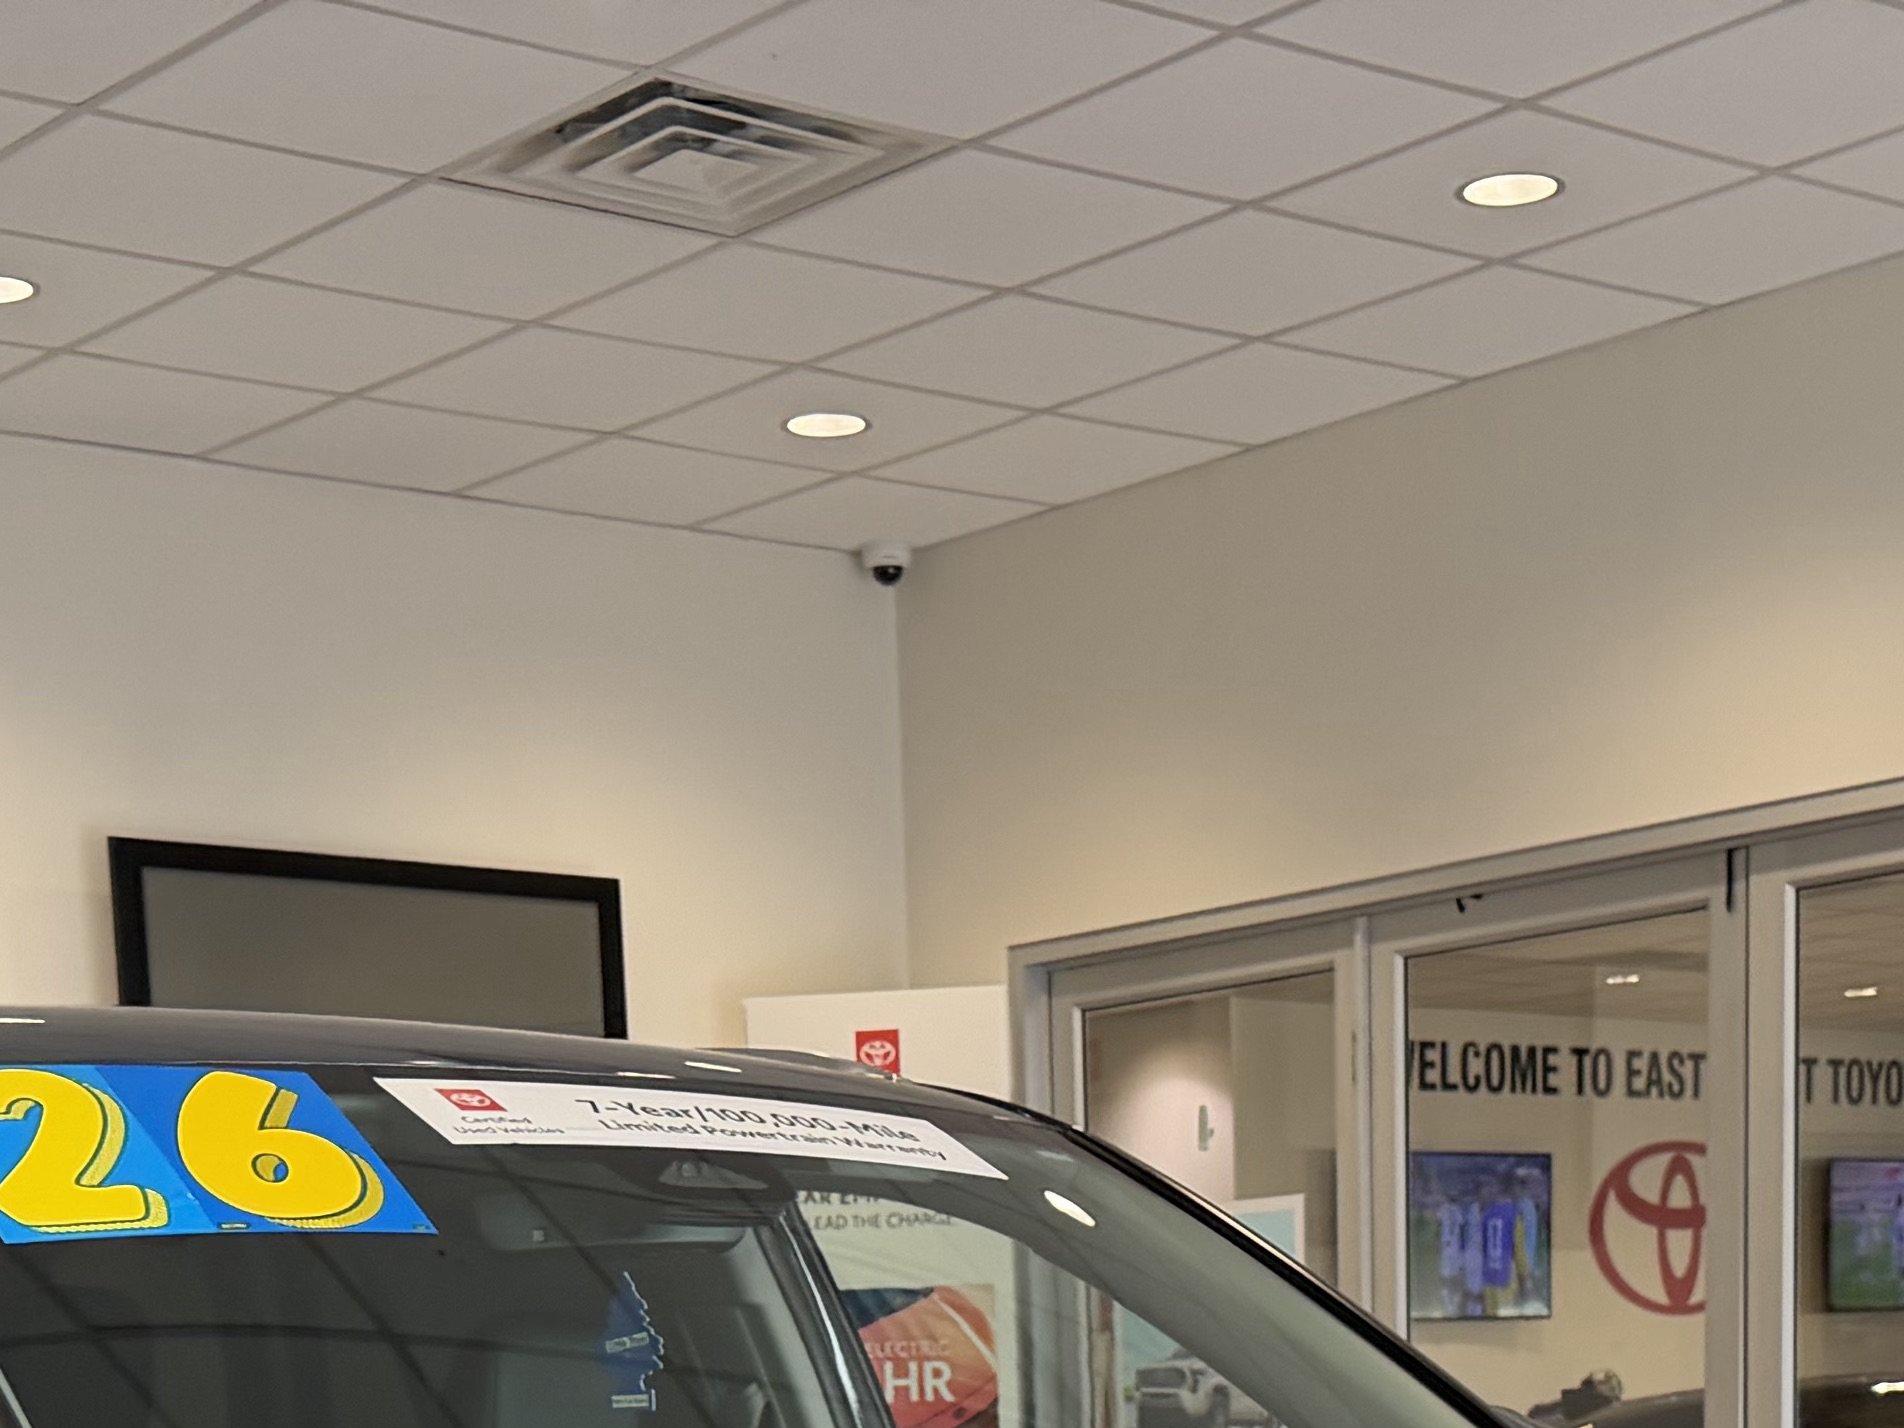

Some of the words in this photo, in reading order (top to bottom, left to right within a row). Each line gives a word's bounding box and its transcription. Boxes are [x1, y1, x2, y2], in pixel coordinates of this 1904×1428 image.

[1570, 1048, 1612, 1098] TO
[1625, 1050, 1707, 1100] EAST
[575, 1099, 921, 1143] 7-Year/100,000-Mile
[598, 1118, 700, 1136] Limited
[700, 1125, 838, 1146] Powertrain
[838, 1135, 947, 1161] Warranty
